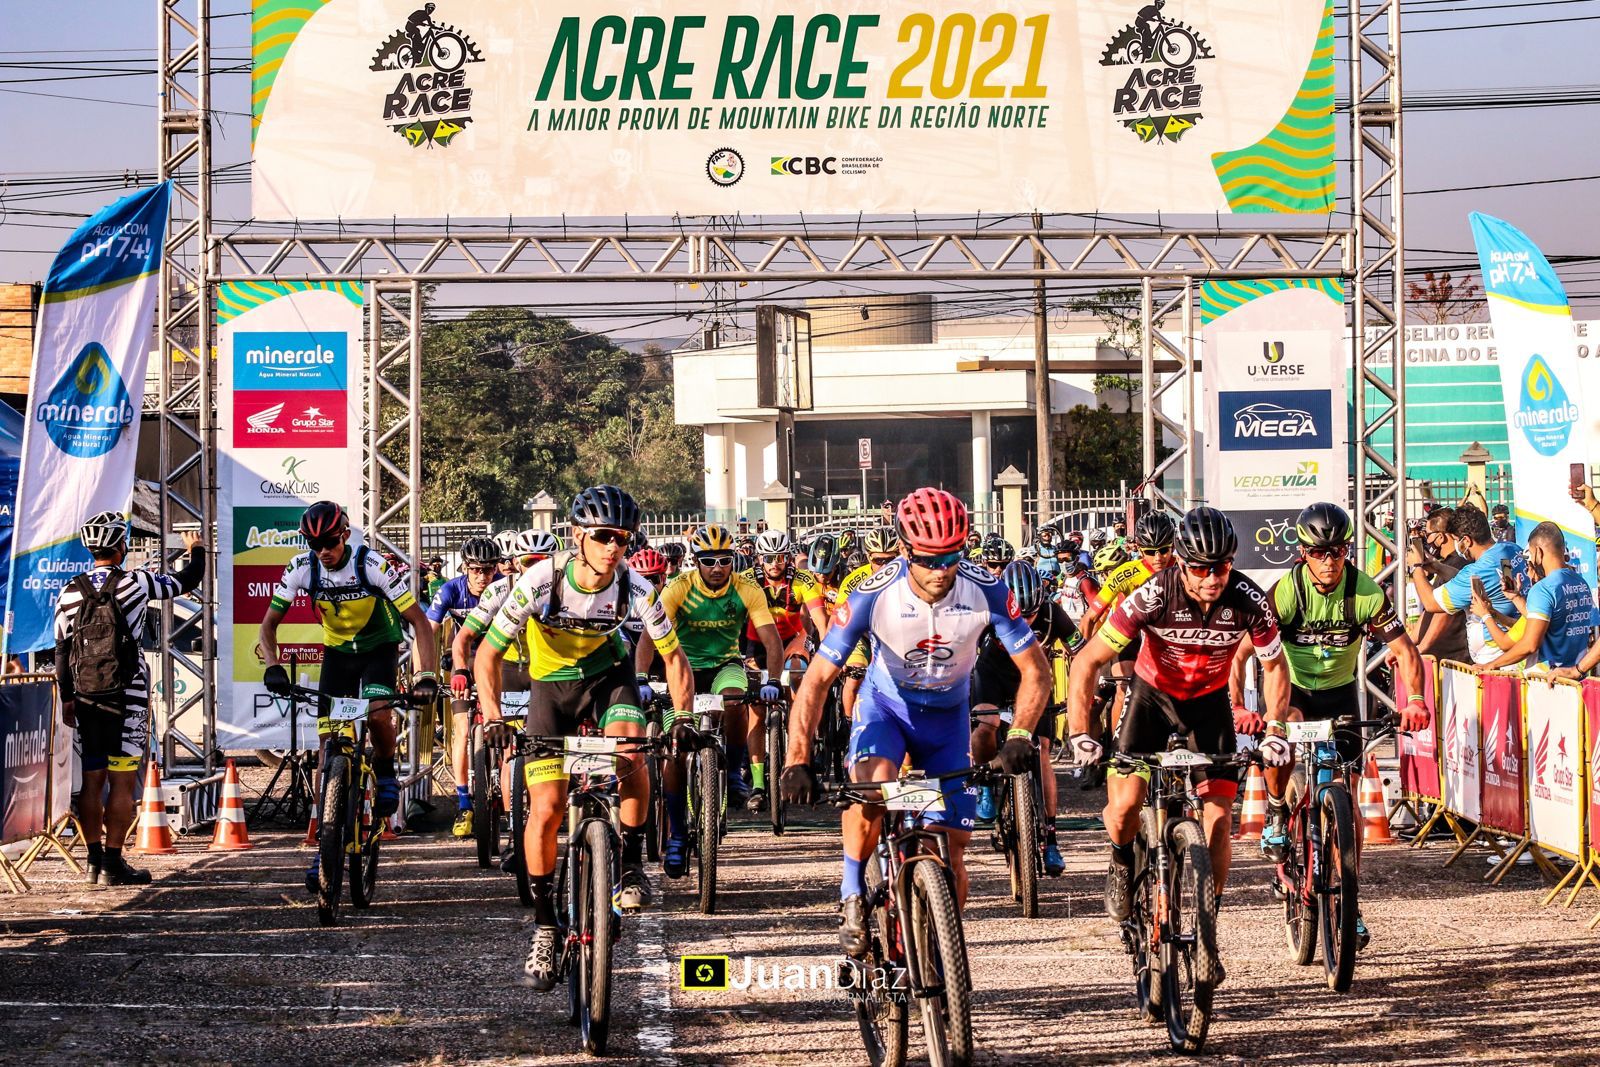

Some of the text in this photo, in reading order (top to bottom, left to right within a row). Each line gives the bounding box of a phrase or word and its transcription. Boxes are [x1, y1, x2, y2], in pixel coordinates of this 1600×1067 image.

[534, 12, 1050, 102] ACRE RACE 2021
[395, 69, 466, 95] ACRE
[1127, 65, 1196, 90] ACRE
[382, 88, 472, 120] RACE
[1112, 84, 1204, 115] RACE
[526, 102, 1050, 132] A MAIOR PROVA DE MOUNTAIN BIKE DA REGIÃO NORTE
[710, 152, 726, 165] FAC
[788, 156, 837, 175] CBC
[124, 222, 149, 236] COM
[246, 344, 335, 365] minerale
[1455, 346, 1481, 362] DO
[291, 418, 335, 427] Grupo Star
[1514, 400, 1579, 429] minerale
[83, 432, 112, 441] Mineral
[1234, 419, 1318, 438] MEGA
[72, 439, 101, 448] Natural
[23, 575, 42, 590] do
[843, 570, 869, 596] MEGA
[1107, 566, 1141, 592] MEGA
[247, 582, 270, 597] SAN
[1235, 581, 1273, 628] prologo
[687, 619, 737, 628] HONDA
[1162, 629, 1240, 642] AUDAX
[341, 706, 357, 714] 038
[609, 708, 644, 719] Armazém
[4, 714, 48, 769] minerale
[527, 762, 562, 776] Armazém
[903, 794, 924, 804] 023
[1534, 784, 1552, 801] HONDA
